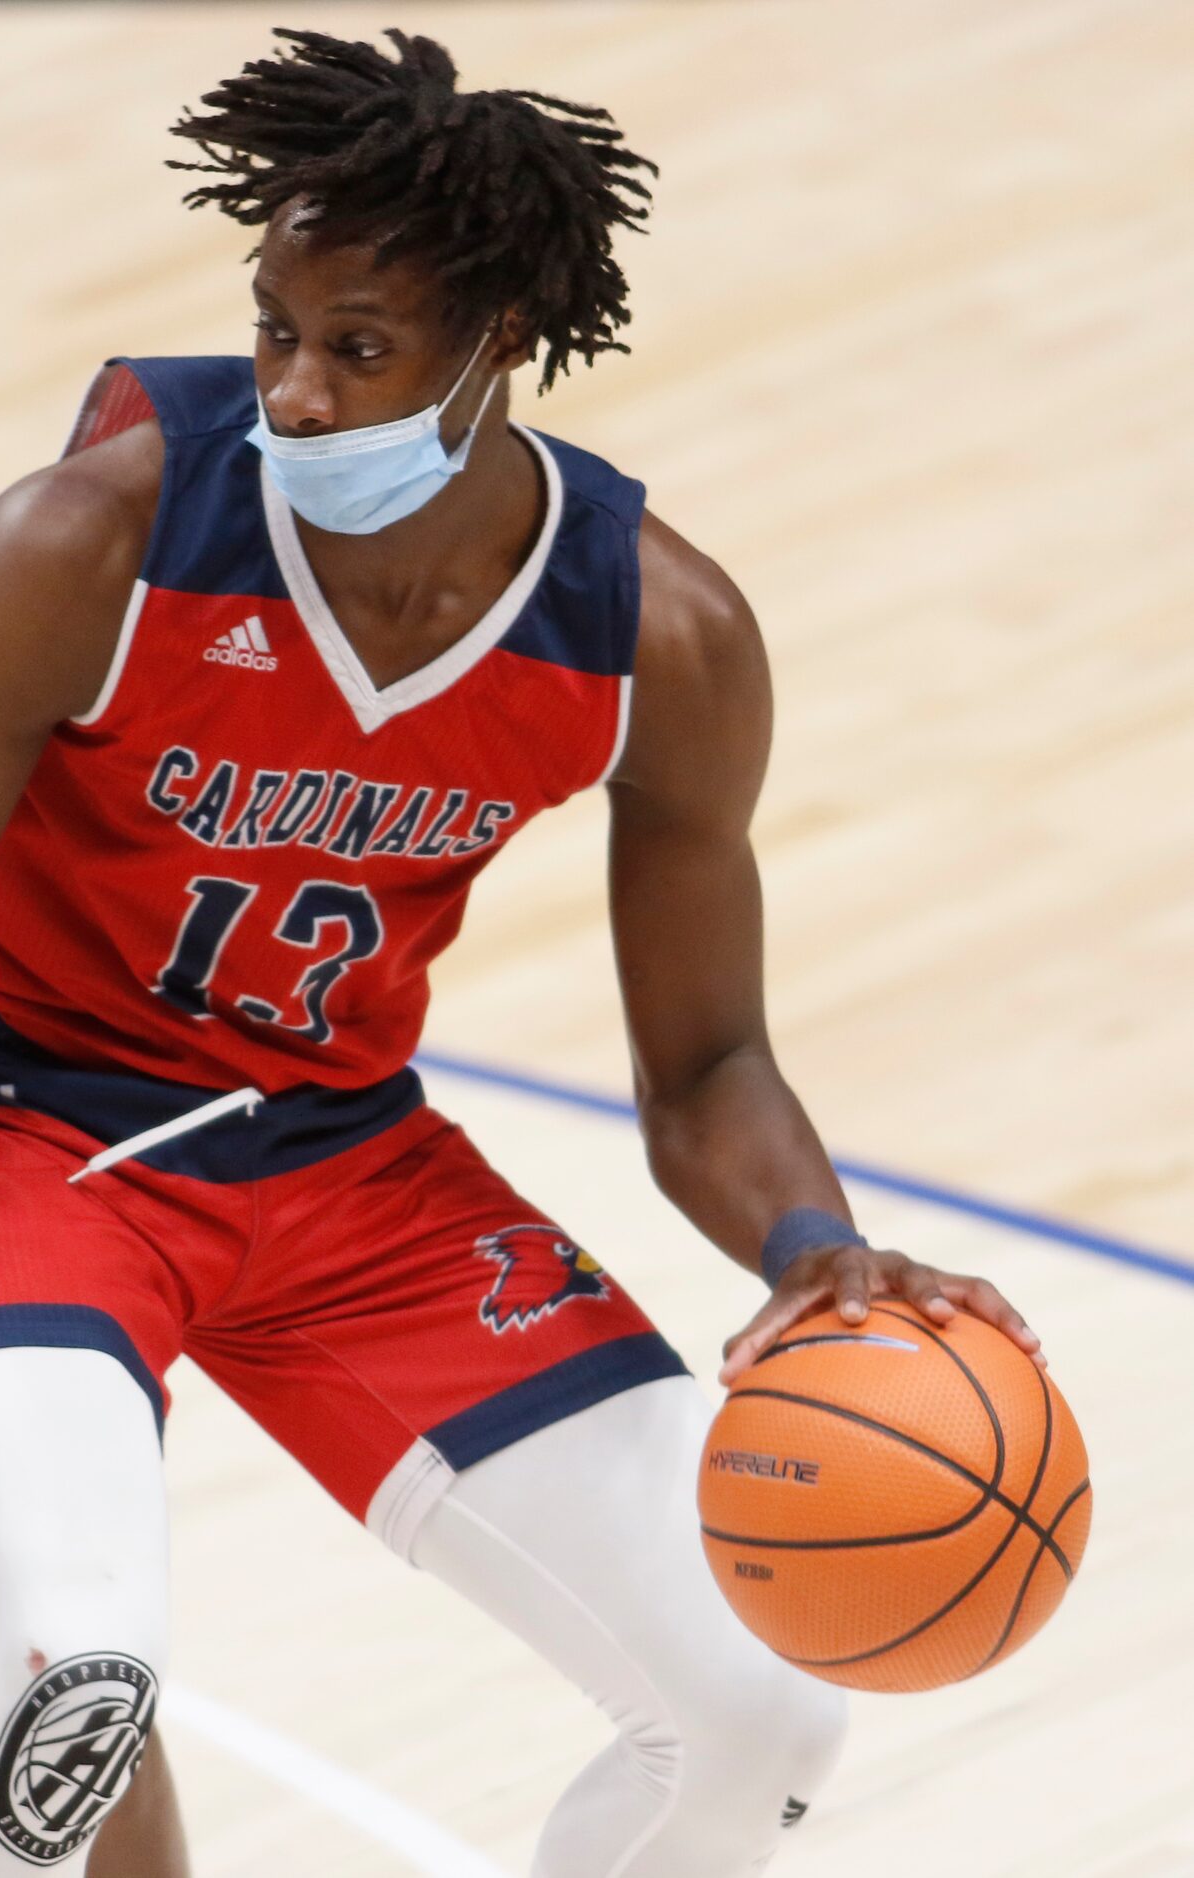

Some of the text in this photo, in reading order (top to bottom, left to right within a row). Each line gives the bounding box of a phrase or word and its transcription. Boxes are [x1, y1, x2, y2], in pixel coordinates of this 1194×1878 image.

[203, 645, 278, 671] adidas
[146, 745, 513, 861] CARDINALS
[149, 875, 384, 1045] 13
[708, 1449, 820, 1486] HYPERELITE
[31, 1662, 148, 1709] HOOPFEST
